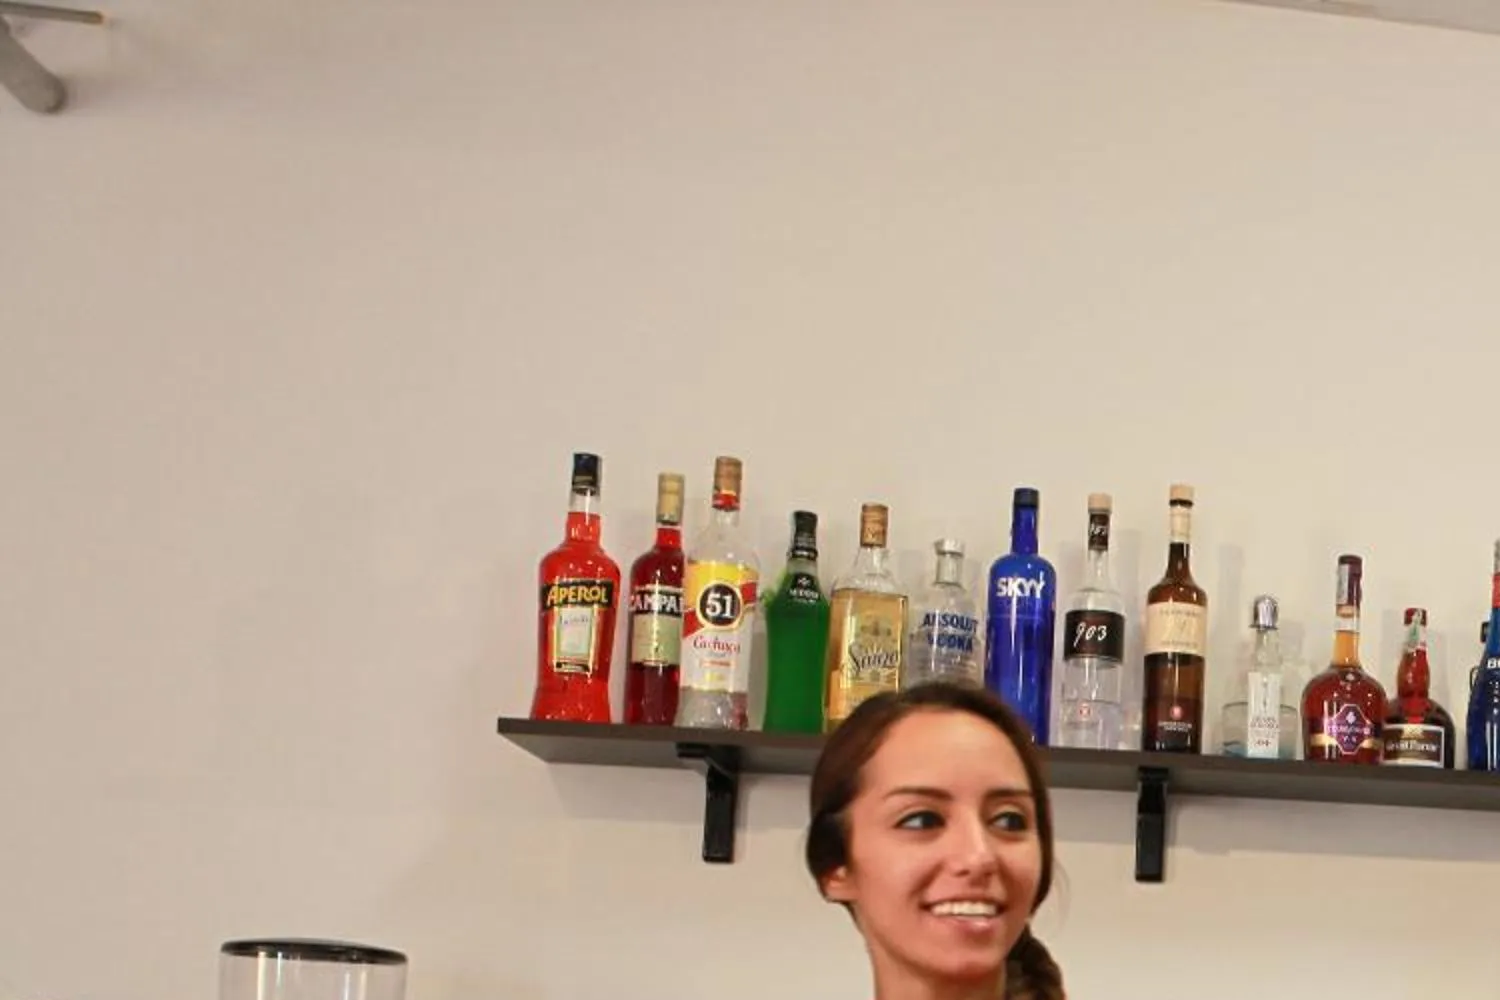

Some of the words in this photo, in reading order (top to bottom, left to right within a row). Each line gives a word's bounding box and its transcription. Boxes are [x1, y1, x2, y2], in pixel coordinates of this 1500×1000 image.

[546, 584, 609, 605] APEROL
[996, 571, 1046, 598] SKYY
[706, 593, 734, 618] 51
[923, 612, 979, 633] ABSOLUT
[927, 632, 974, 652] VODKA
